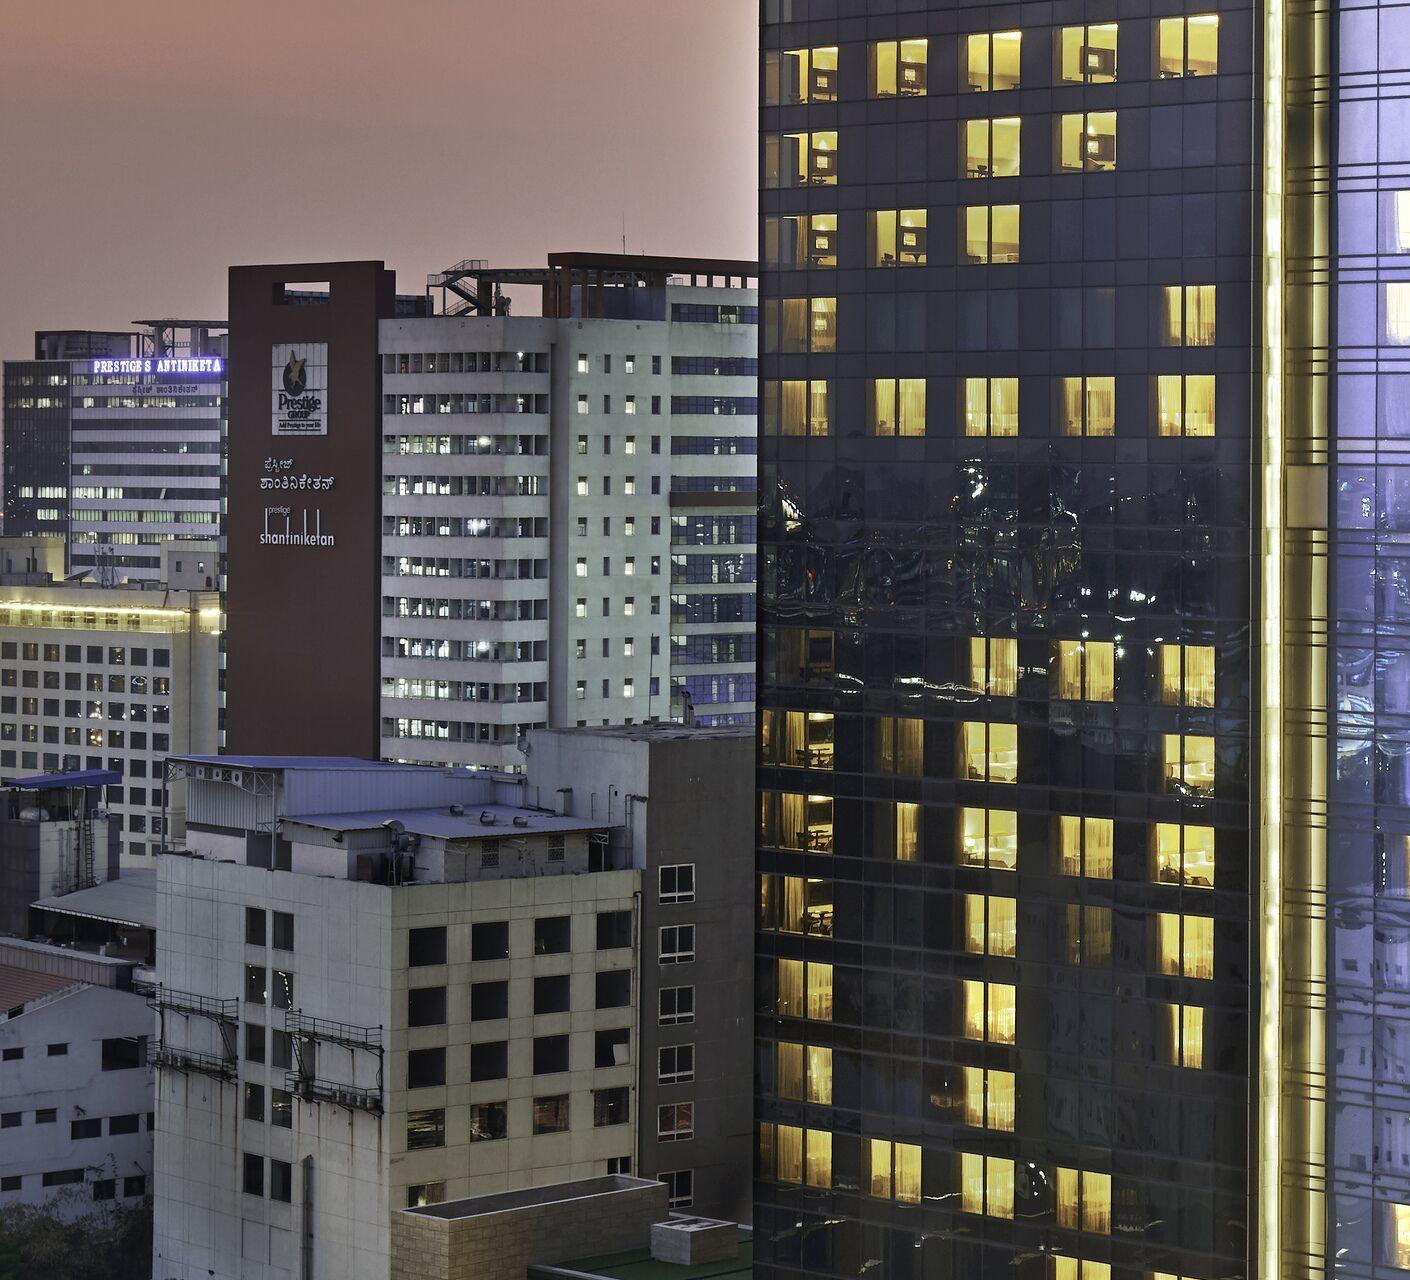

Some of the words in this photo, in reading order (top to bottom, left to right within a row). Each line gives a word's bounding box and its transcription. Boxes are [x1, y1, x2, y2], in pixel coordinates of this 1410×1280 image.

[93, 360, 142, 373] PRESTIGE
[278, 393, 322, 412] Prestige
[287, 410, 311, 419] GROUP
[260, 473, 335, 490] ಶಾಂತಿನಿಕೇತನ್
[268, 506, 291, 517] prestige
[260, 507, 335, 546] shantiniketan
